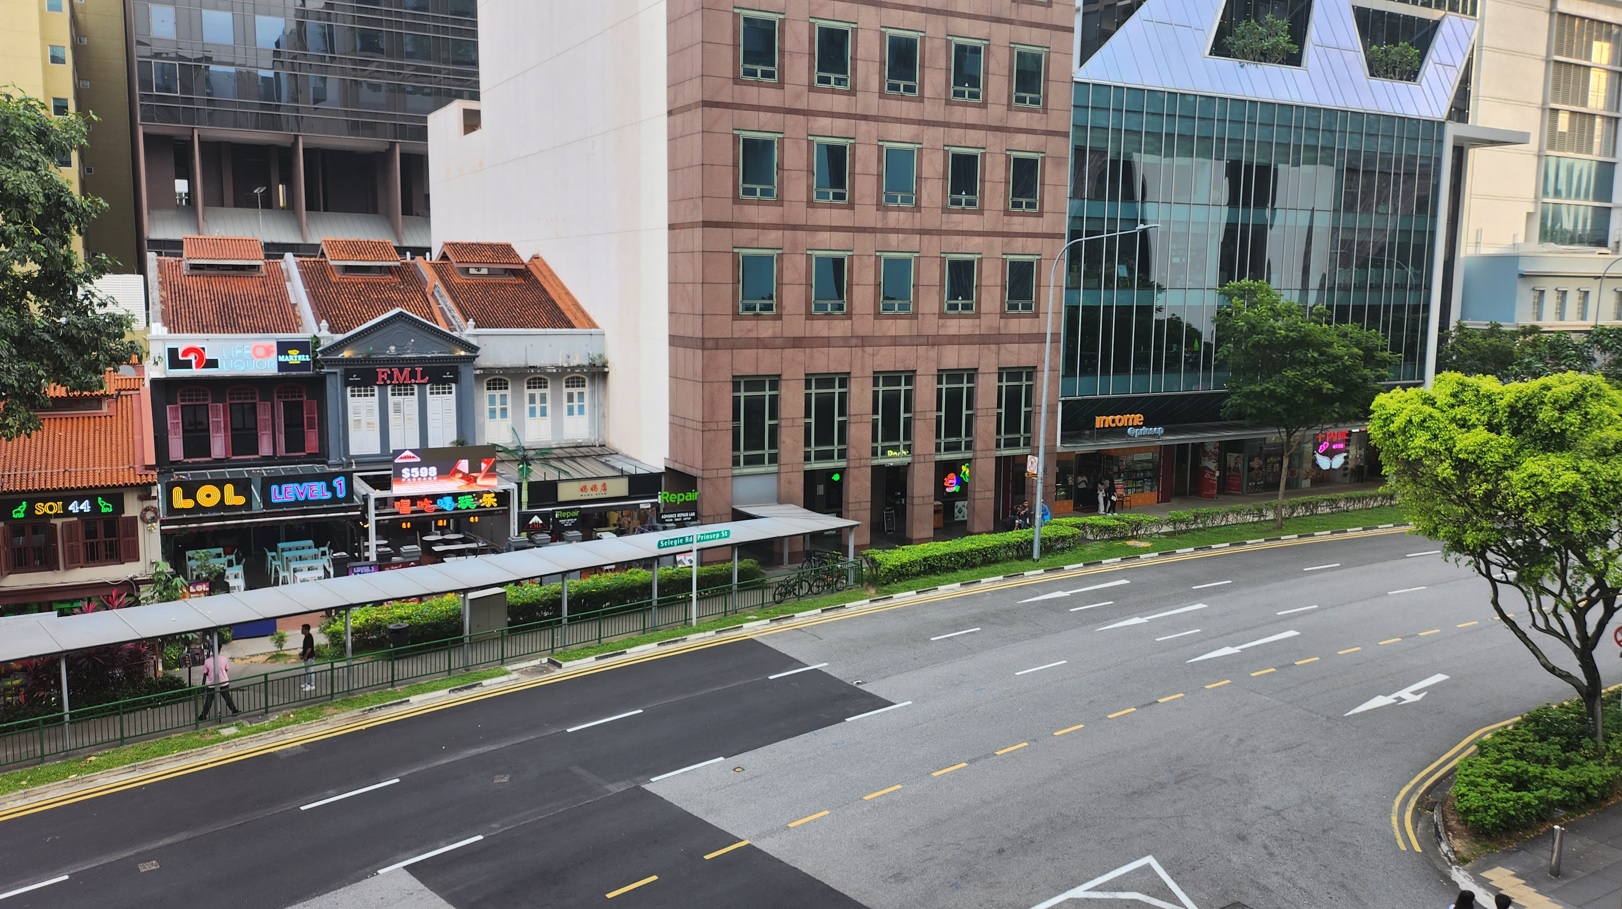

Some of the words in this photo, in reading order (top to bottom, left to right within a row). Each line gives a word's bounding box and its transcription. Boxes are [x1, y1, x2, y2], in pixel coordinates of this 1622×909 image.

[222, 346, 251, 359] LIFE
[252, 344, 275, 358] OF
[278, 354, 311, 362] MARTELL
[223, 359, 276, 371] LIQUOR
[1127, 426, 1164, 437] @prinsep
[401, 466, 437, 478] $598
[271, 481, 332, 503] LEVEL
[333, 476, 346, 498] 1
[172, 483, 246, 509] LOL
[658, 489, 699, 505] iRepair
[35, 501, 63, 515] SOI
[68, 500, 91, 513] 44
[555, 510, 580, 518] iRepair
[660, 537, 683, 547] Selegie
[685, 535, 693, 543] Rd
[697, 532, 720, 542] Prinsep
